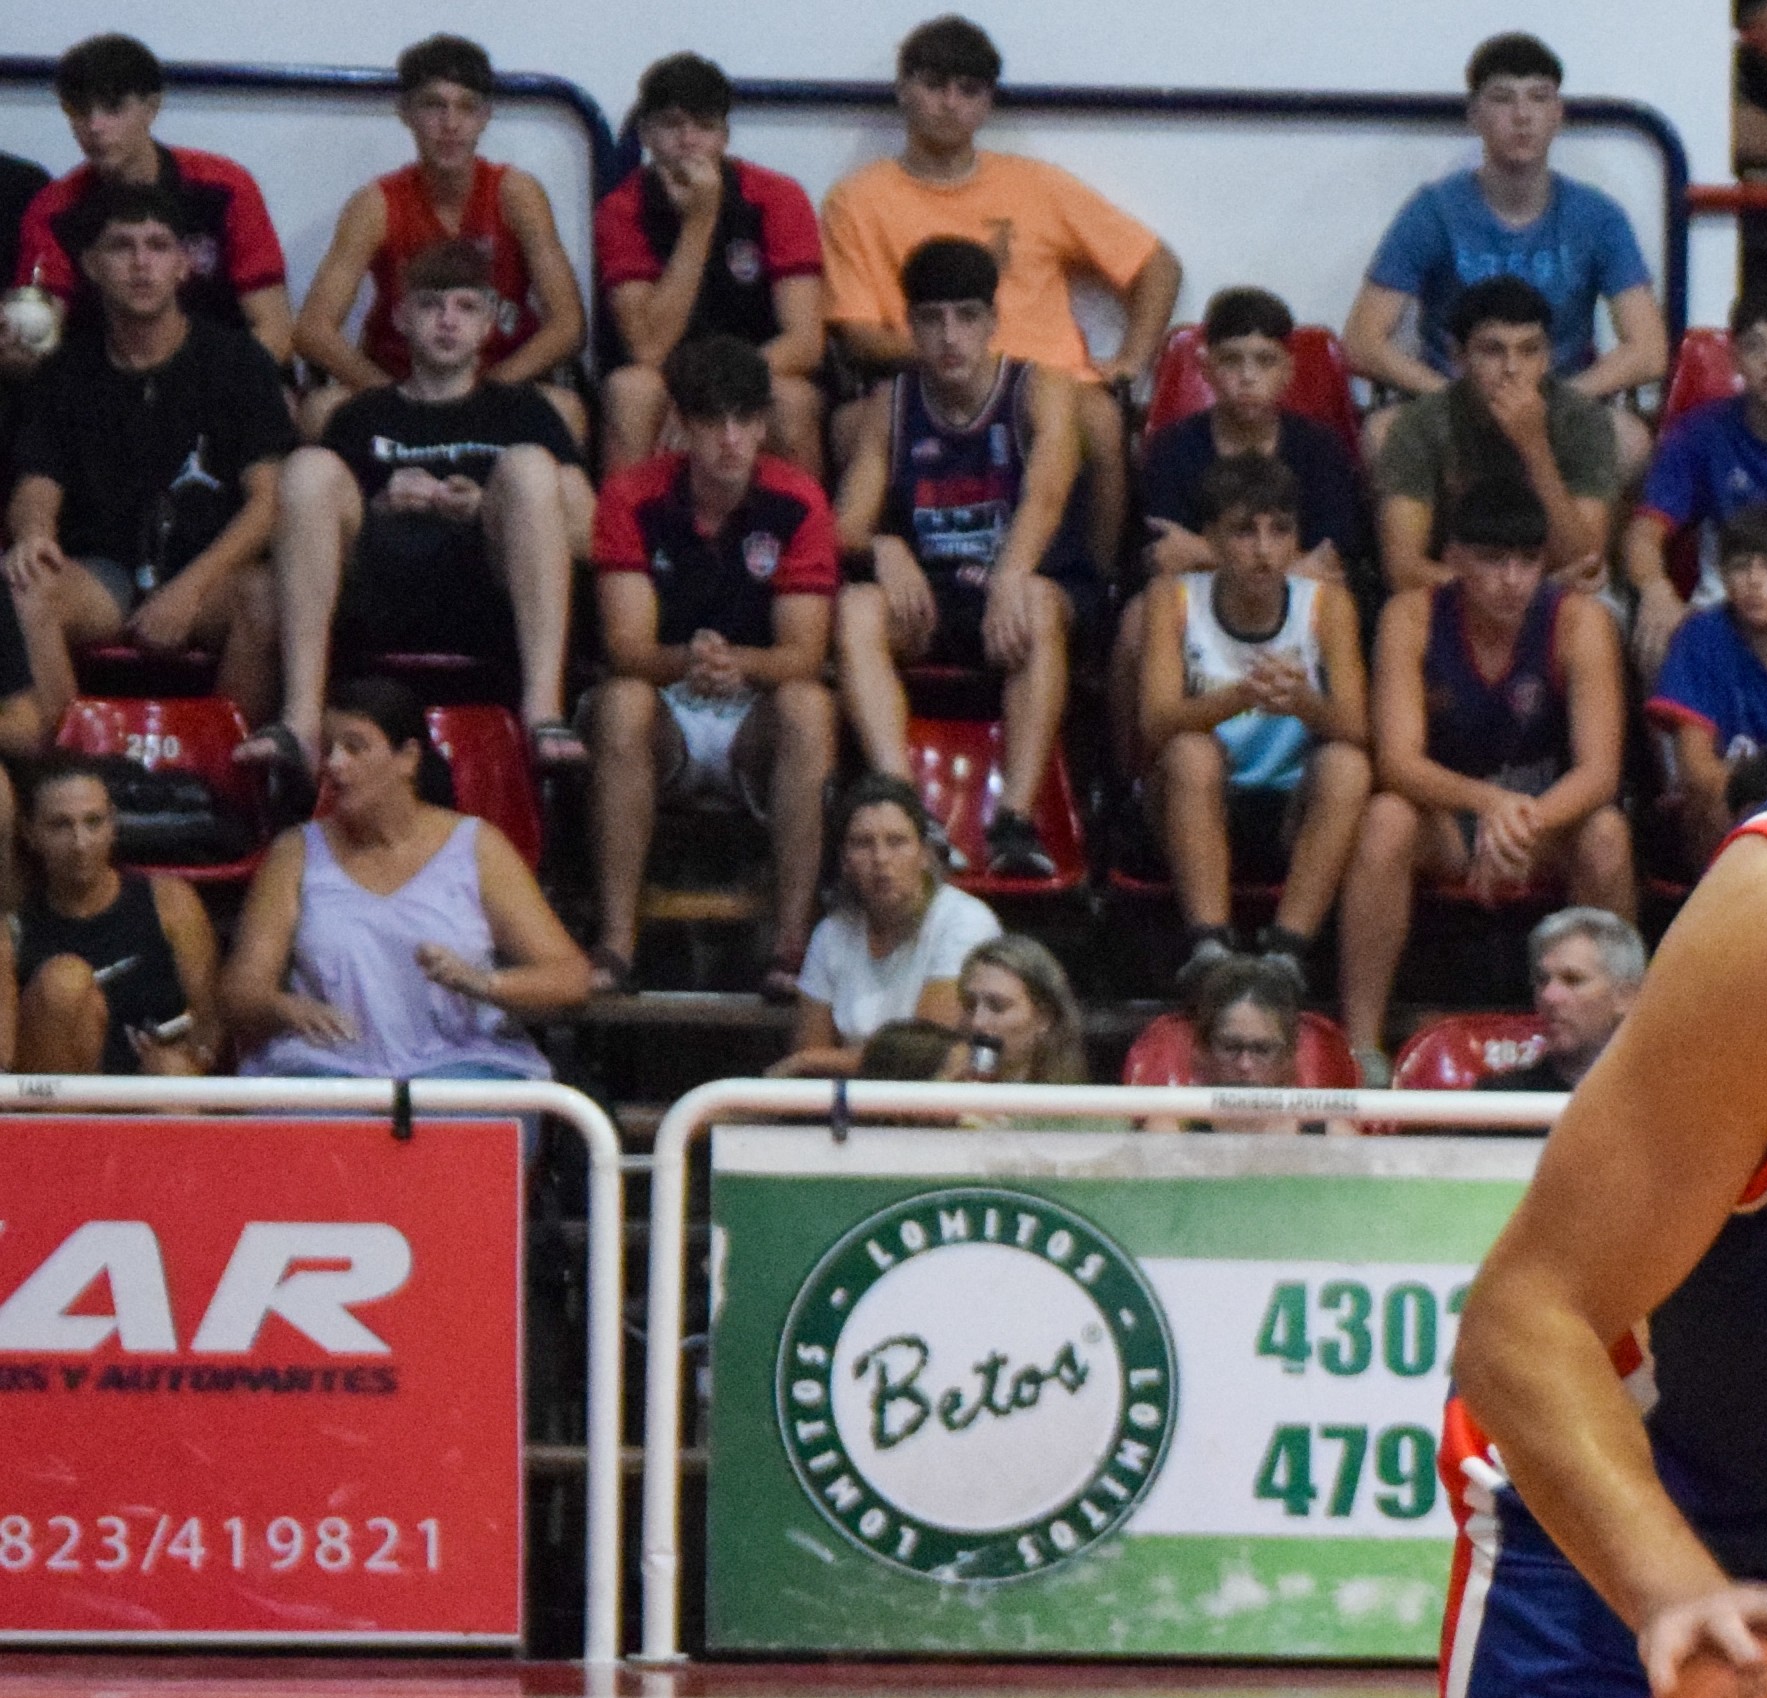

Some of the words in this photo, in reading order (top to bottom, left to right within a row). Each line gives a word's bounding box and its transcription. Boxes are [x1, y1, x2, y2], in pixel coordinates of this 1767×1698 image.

[0, 1219, 414, 1354] AR
[866, 1208, 1105, 1286] LOMITOS
[97, 1365, 397, 1394] AUTOPARTES
[852, 1333, 1089, 1452] Betos
[792, 1343, 920, 1561] LOMITOS
[1018, 1366, 1161, 1568] LOMITOS
